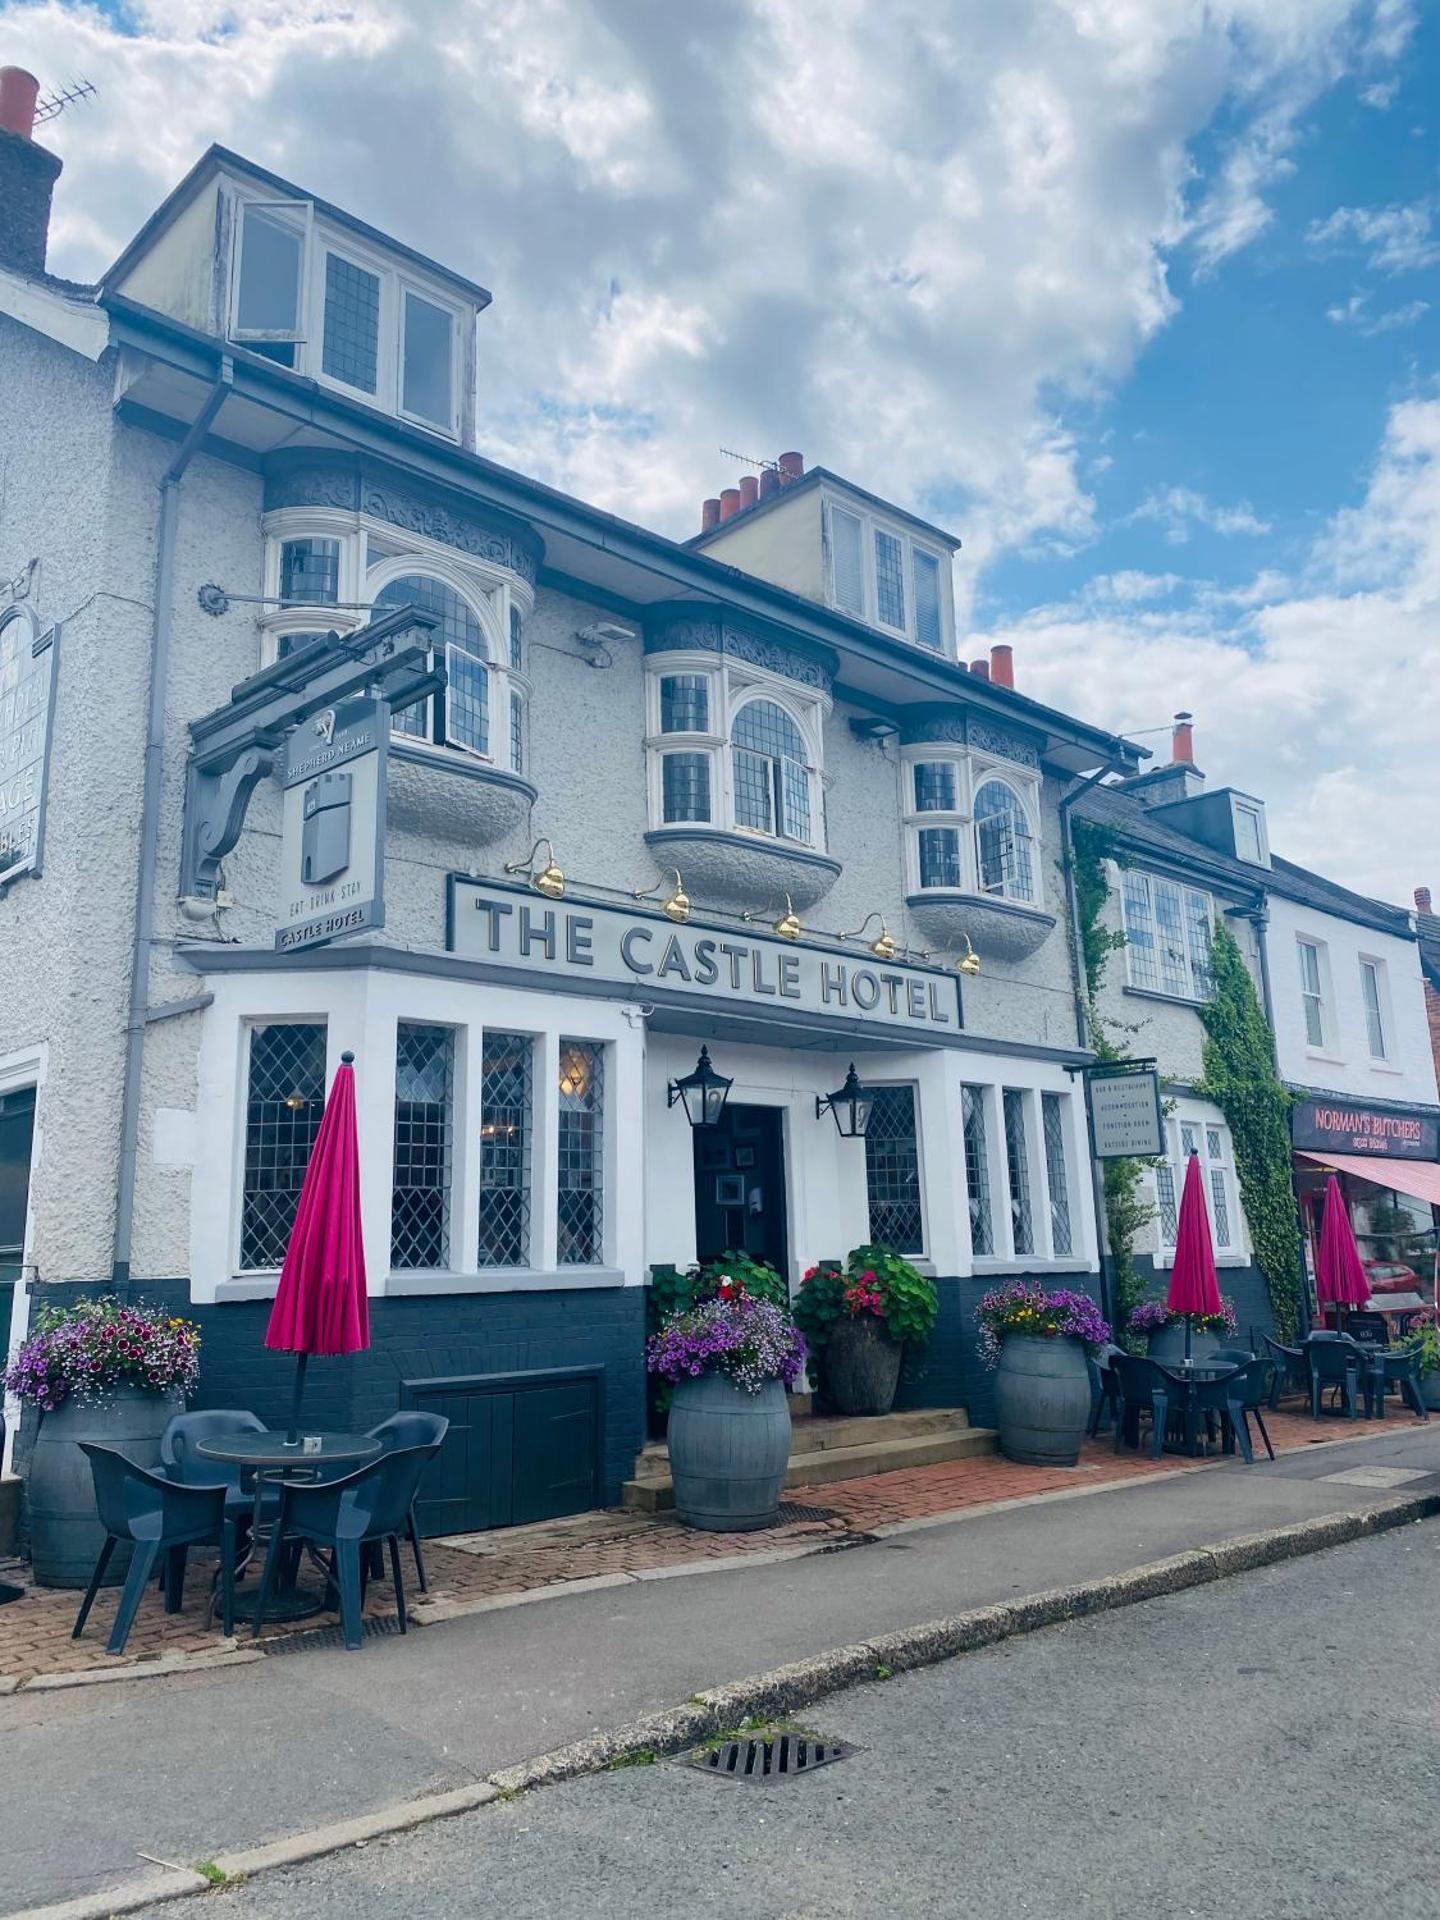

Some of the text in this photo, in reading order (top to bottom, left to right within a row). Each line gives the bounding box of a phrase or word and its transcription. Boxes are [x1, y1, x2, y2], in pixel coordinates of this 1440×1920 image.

[287, 733, 370, 779] SHEPHERD NEAME
[289, 880, 361, 917] EAT DRINK STAY
[280, 909, 365, 947] CASTLE HOTEL
[475, 897, 950, 1023] THE CASTLE HOTEL
[1315, 1109, 1420, 1140] NORMAN'S BUTCHERS
